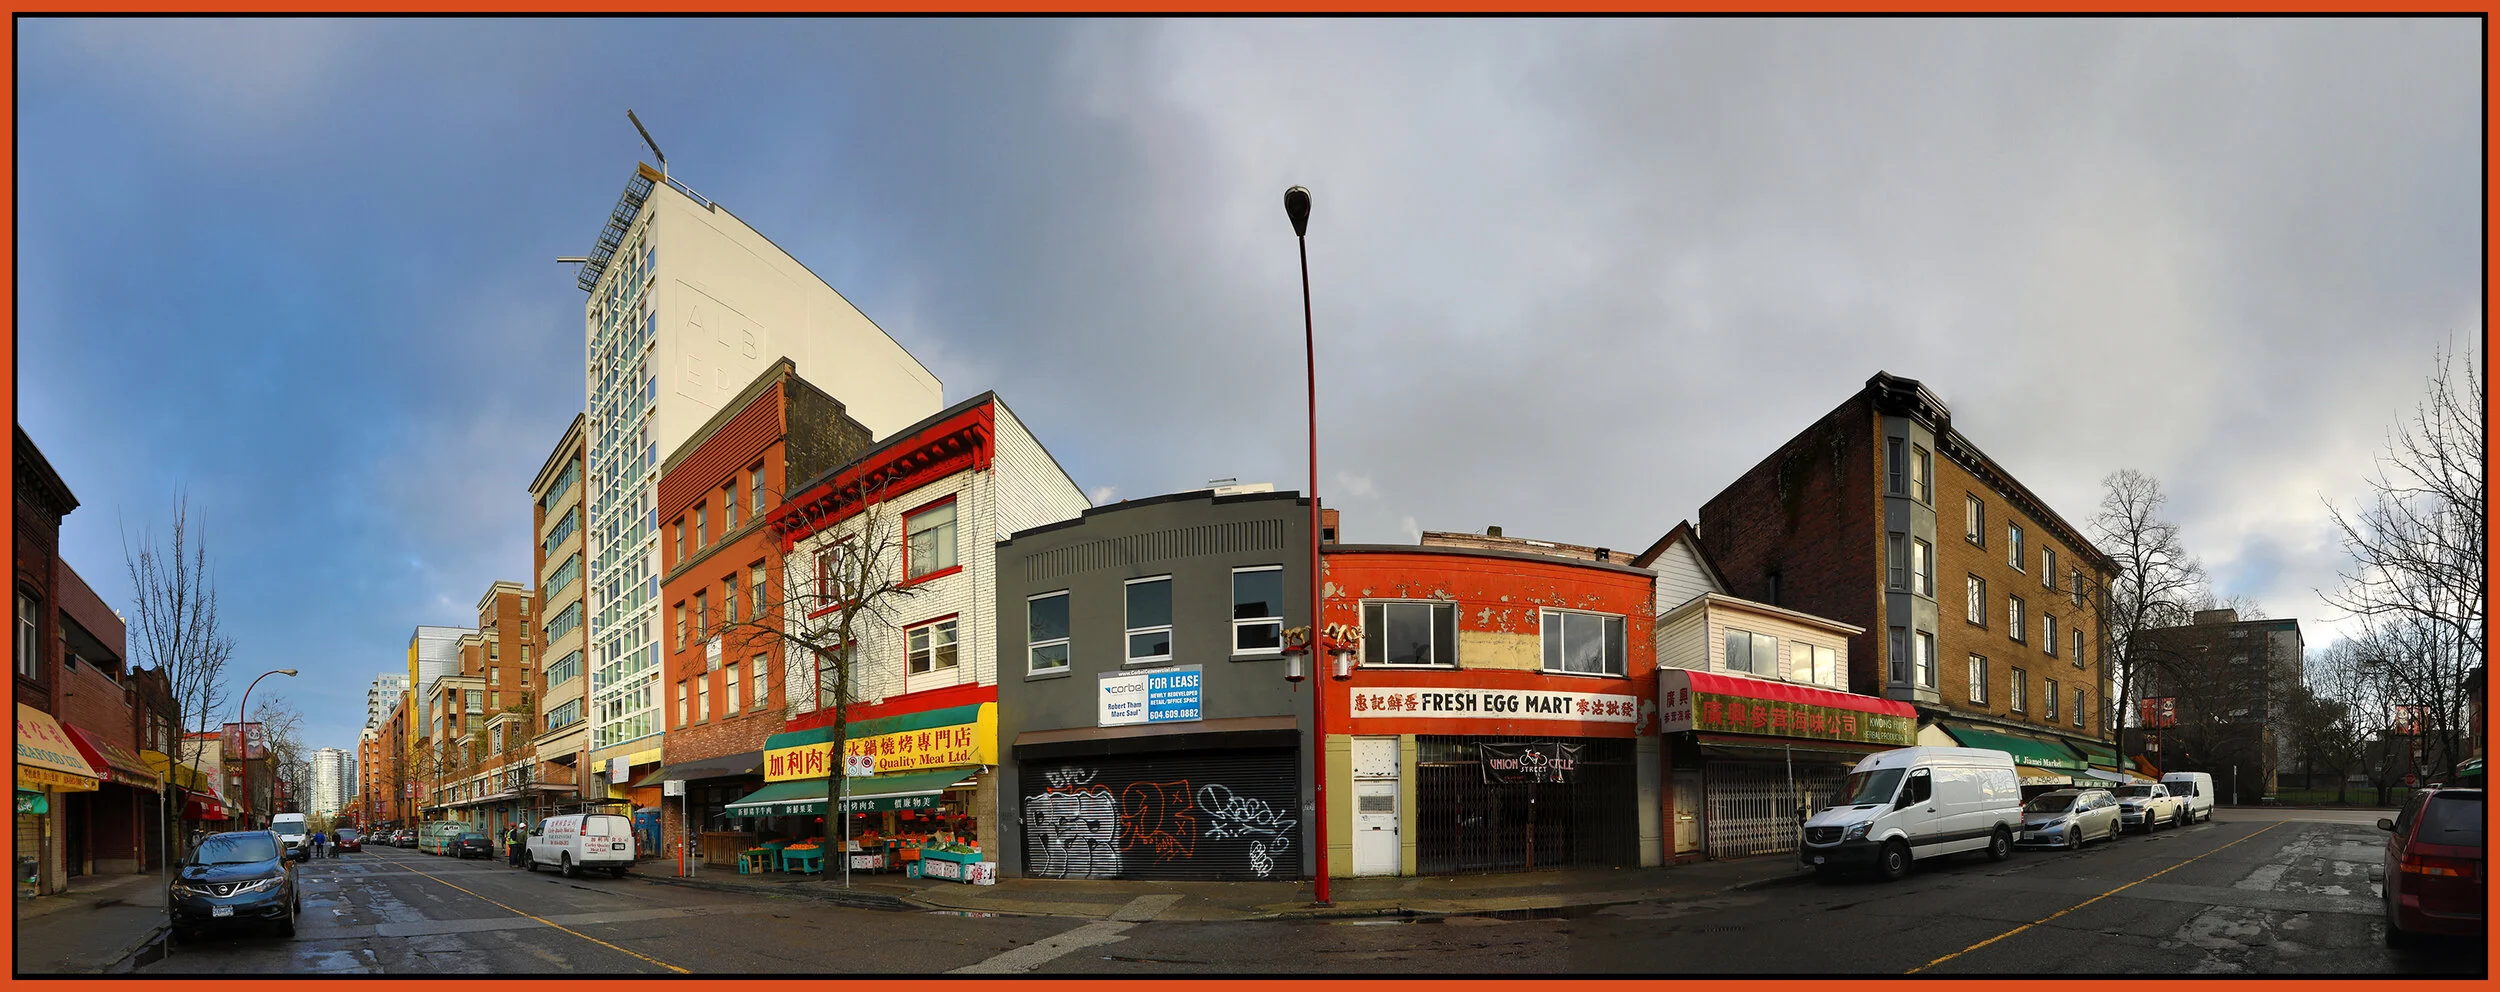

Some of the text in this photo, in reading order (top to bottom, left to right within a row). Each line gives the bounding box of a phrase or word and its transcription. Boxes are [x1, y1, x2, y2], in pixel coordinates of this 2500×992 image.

[1111, 682, 1144, 693] corbel
[1150, 675, 1199, 690] FOR LEASE
[1421, 693, 1572, 713] FRESH EGG MART
[880, 757, 916, 769] Quality
[920, 753, 944, 765] Meat
[948, 750, 971, 762] Ltd.
[1490, 759, 1519, 770] UNION
